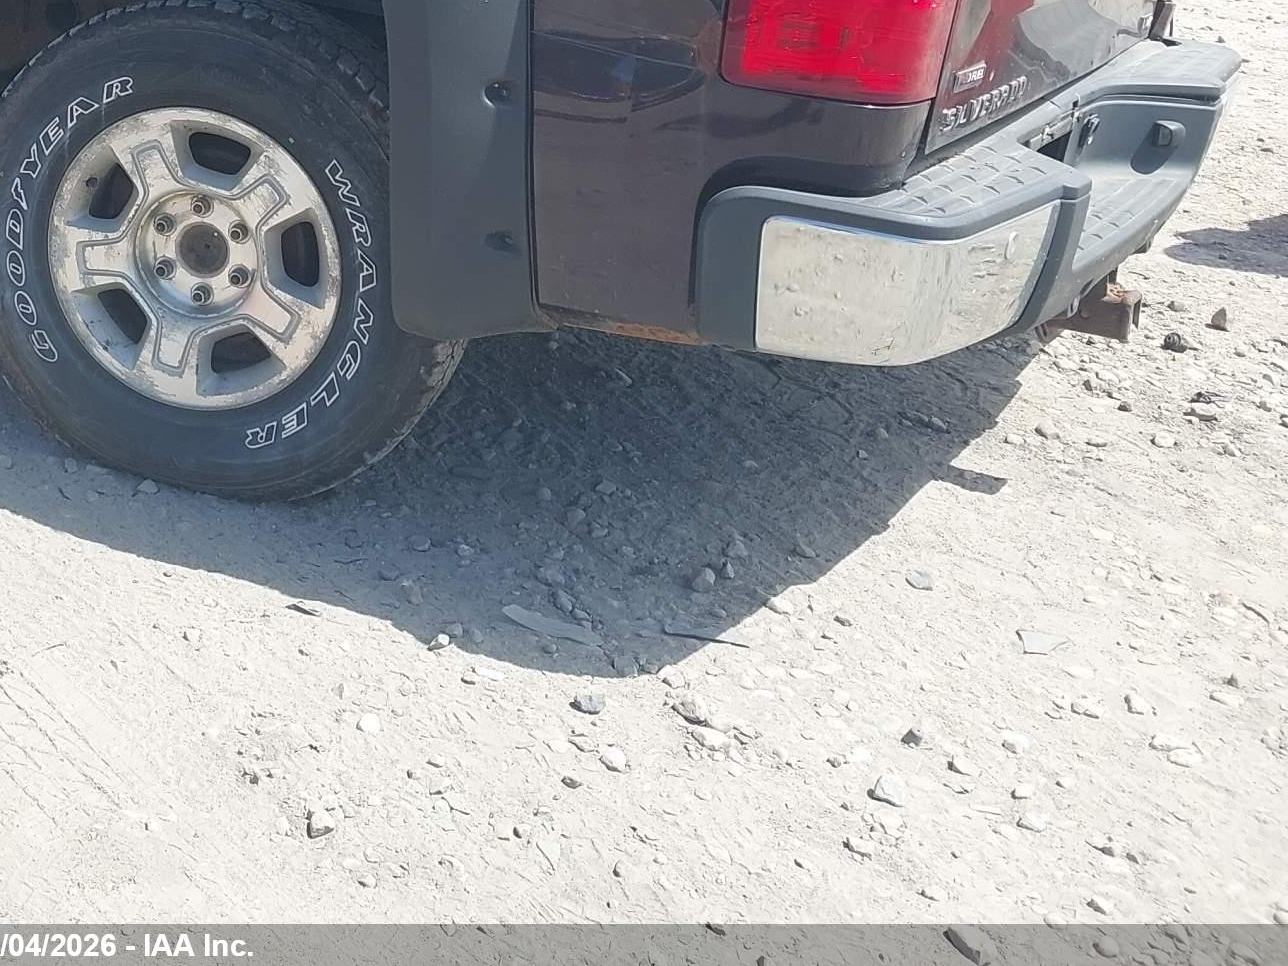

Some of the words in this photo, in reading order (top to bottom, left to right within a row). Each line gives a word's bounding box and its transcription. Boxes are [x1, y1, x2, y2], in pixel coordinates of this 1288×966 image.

[5, 75, 134, 364] GOODYEAR
[940, 75, 1028, 132] SILVERADO
[245, 159, 378, 450] WRANGLER
